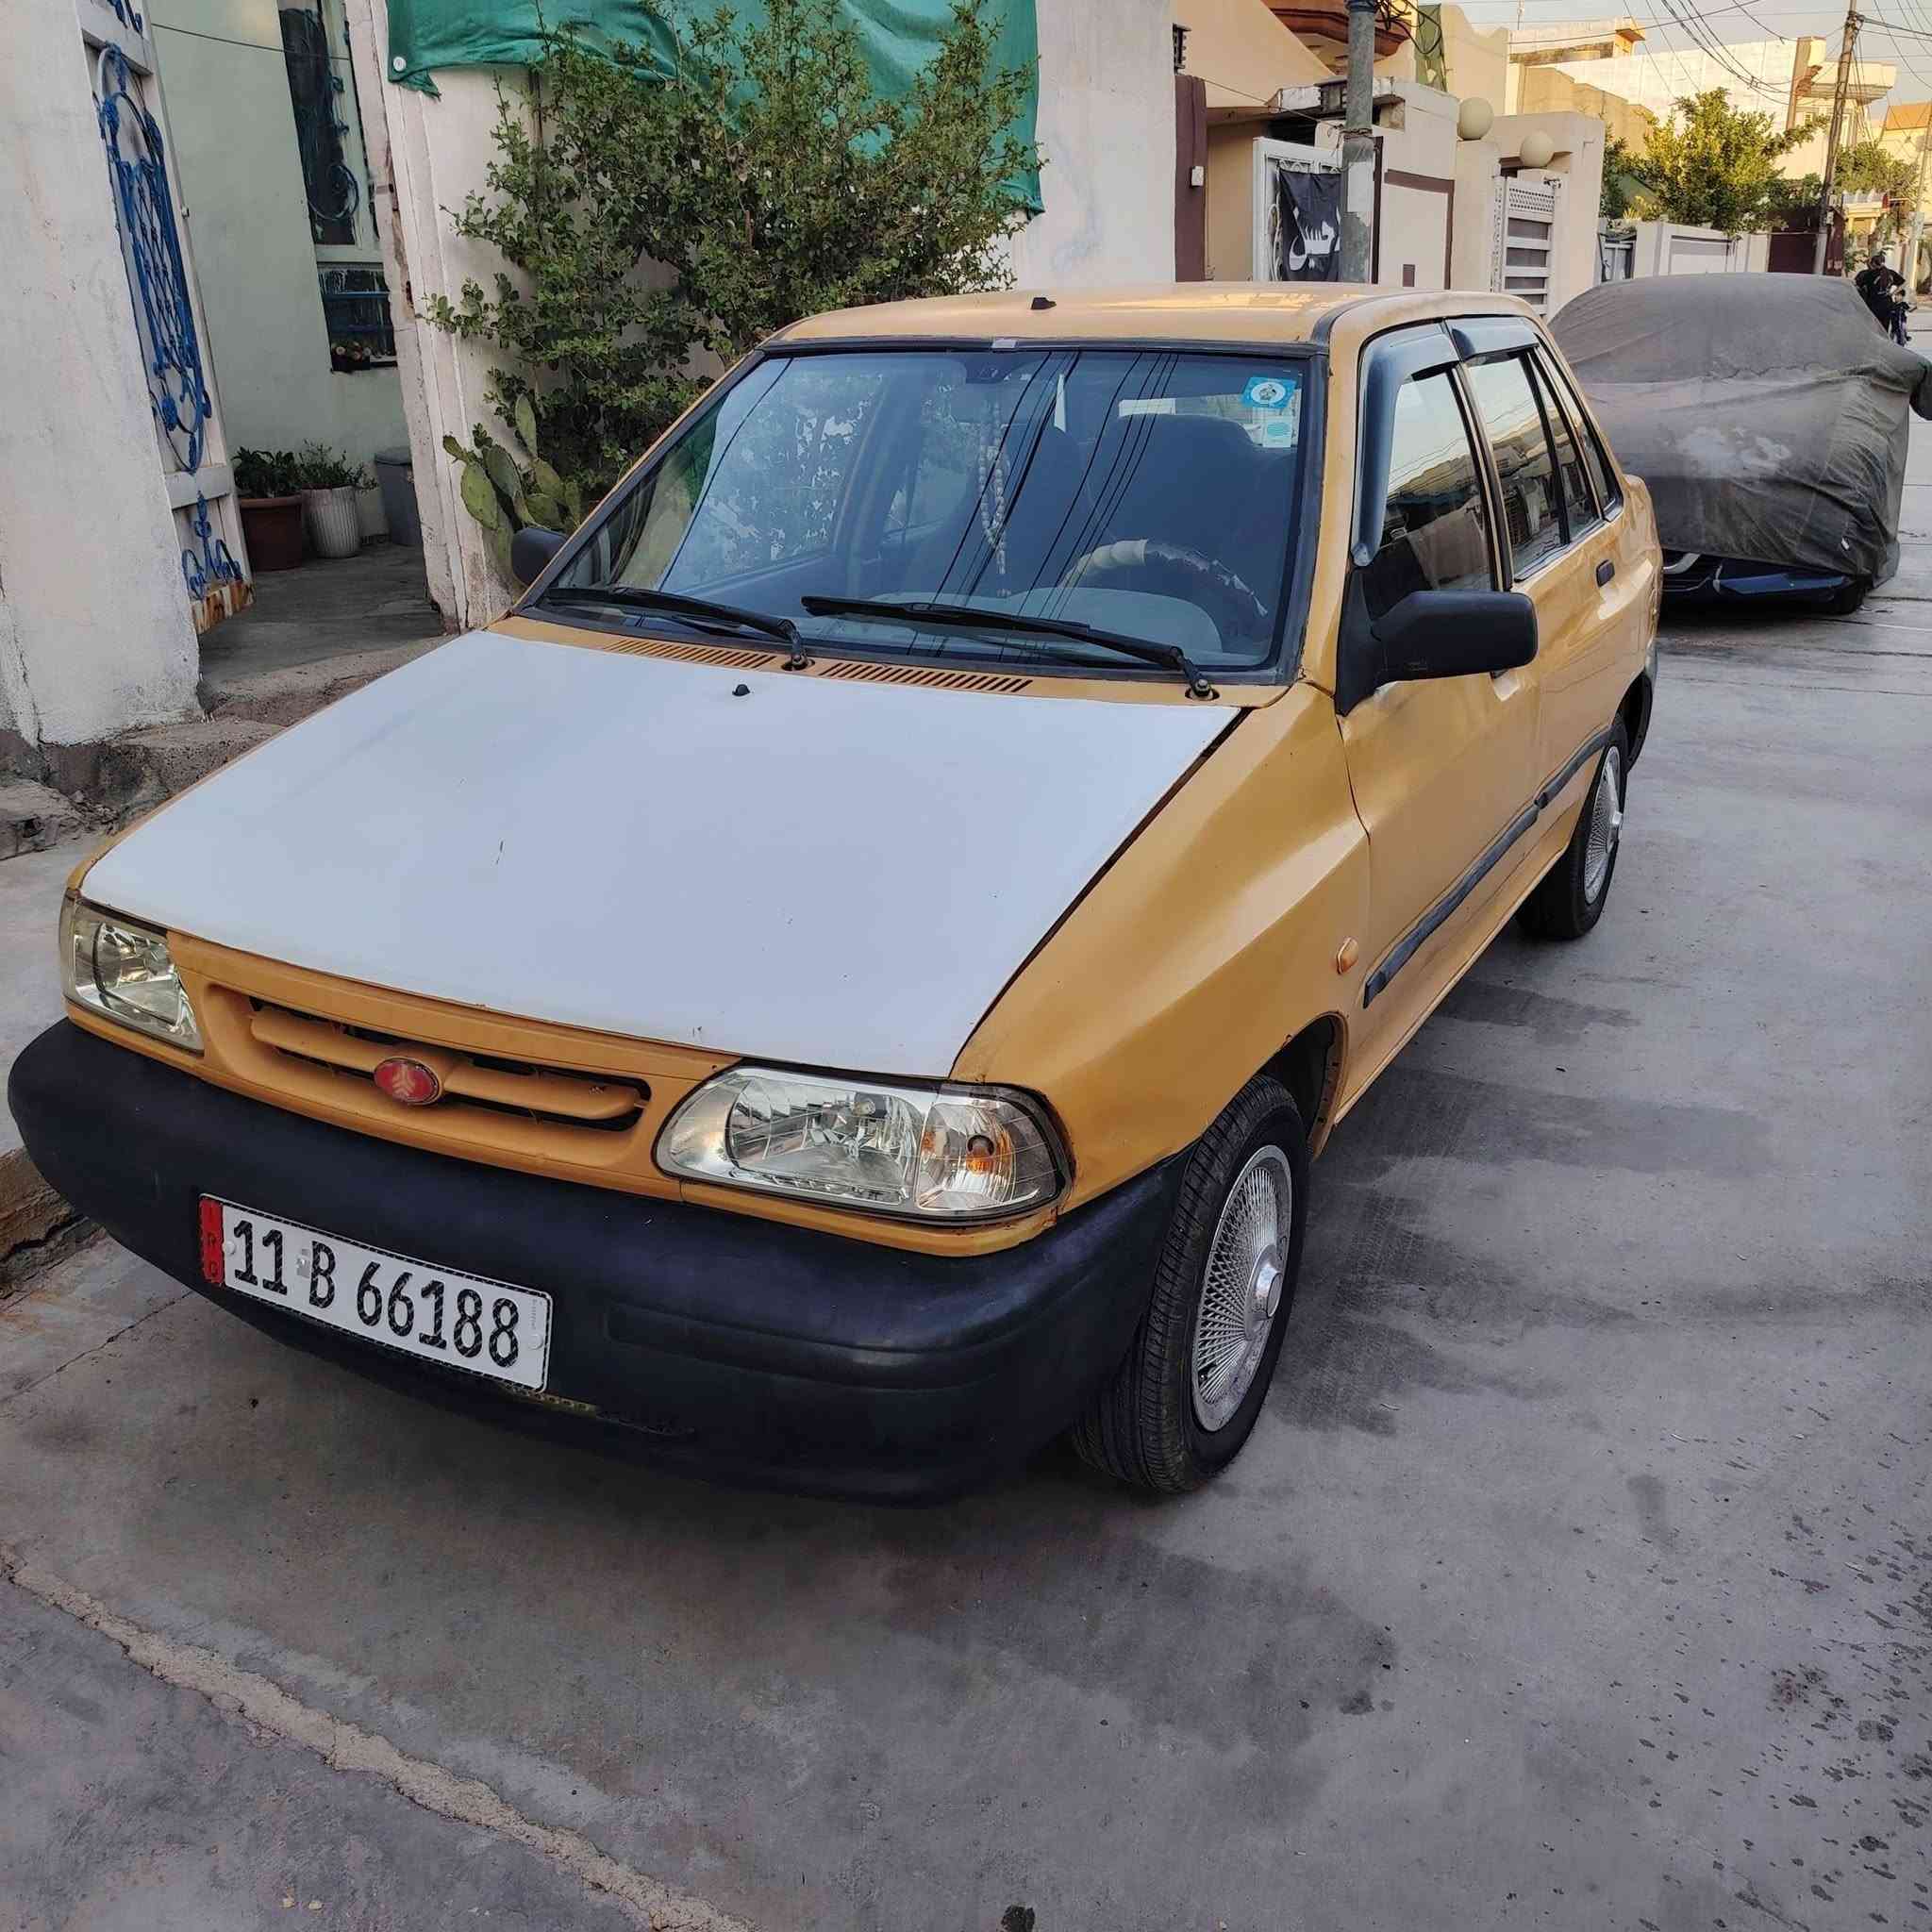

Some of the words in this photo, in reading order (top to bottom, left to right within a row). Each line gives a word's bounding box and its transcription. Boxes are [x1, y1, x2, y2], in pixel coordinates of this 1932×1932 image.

[233, 1220, 288, 1295] 11
[308, 1240, 337, 1309] B
[356, 1260, 521, 1368] 66188
